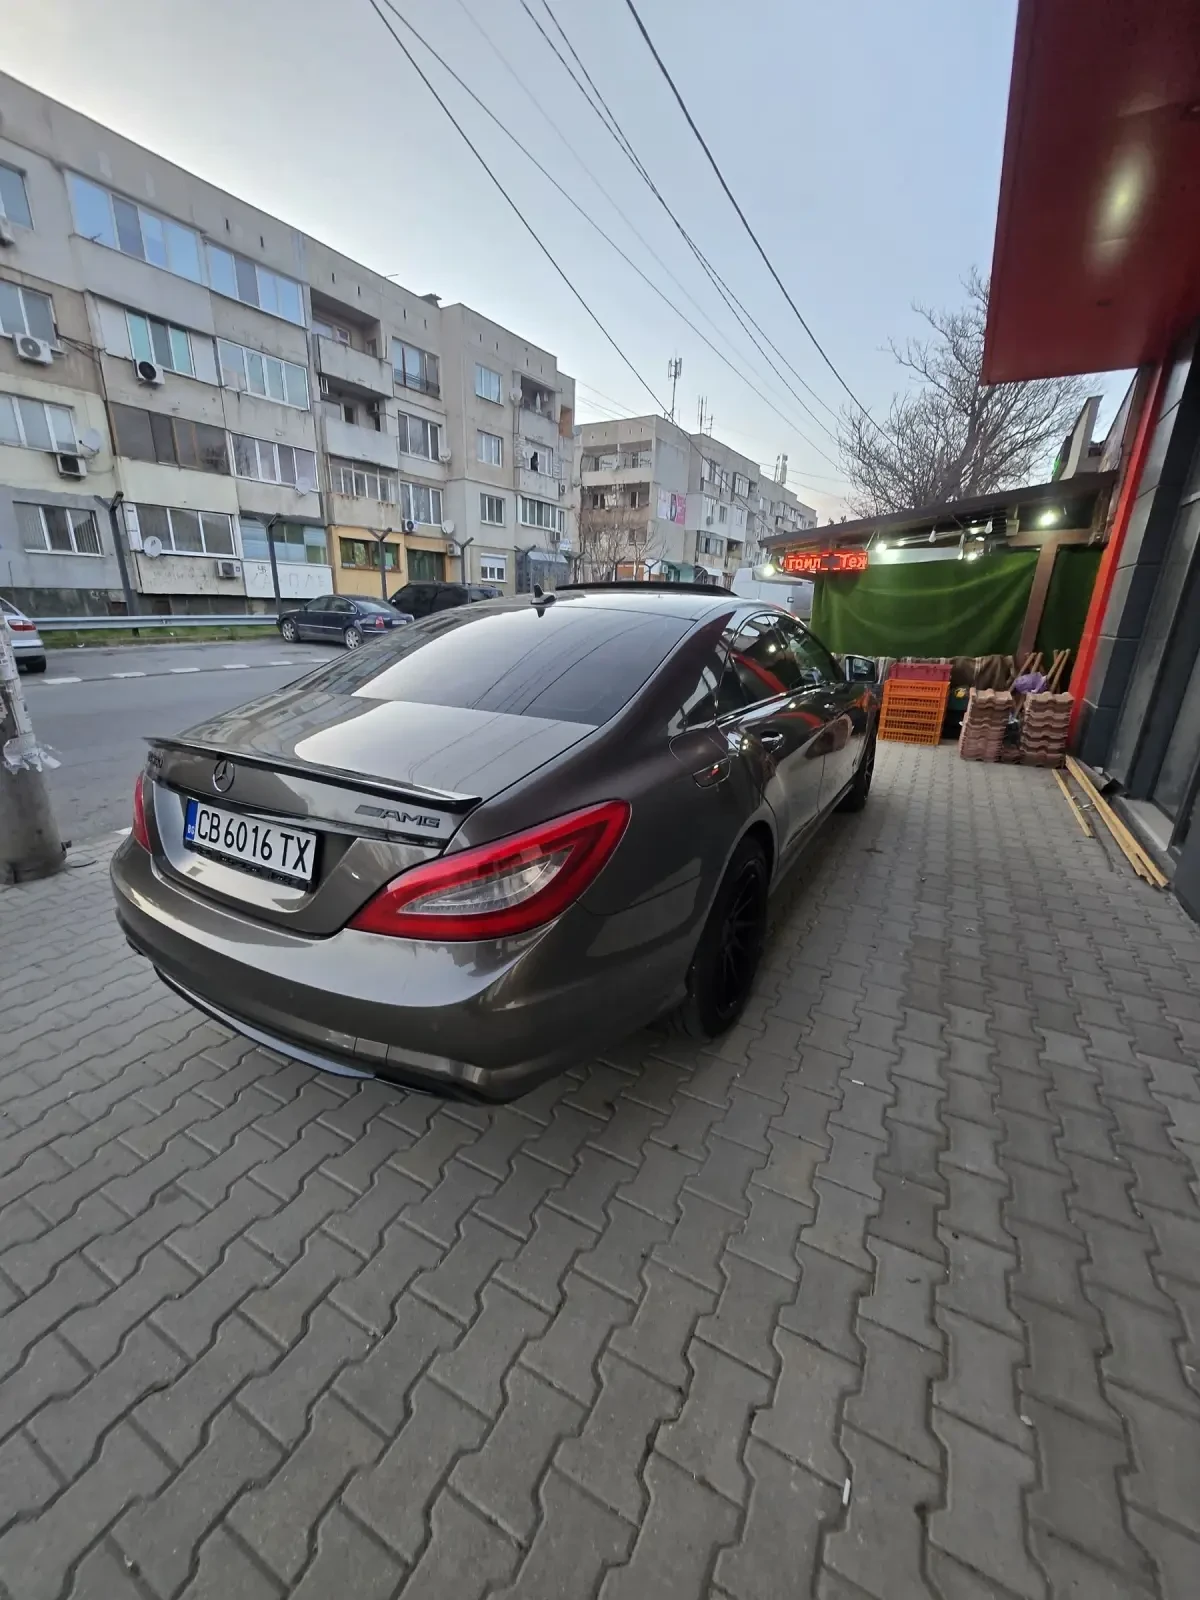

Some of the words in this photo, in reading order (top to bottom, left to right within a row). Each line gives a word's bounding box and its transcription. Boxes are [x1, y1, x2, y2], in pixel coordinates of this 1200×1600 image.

[380, 808, 440, 828] AMG
[187, 824, 195, 835] BG
[223, 818, 273, 860] 6016
[280, 832, 311, 873] TX
